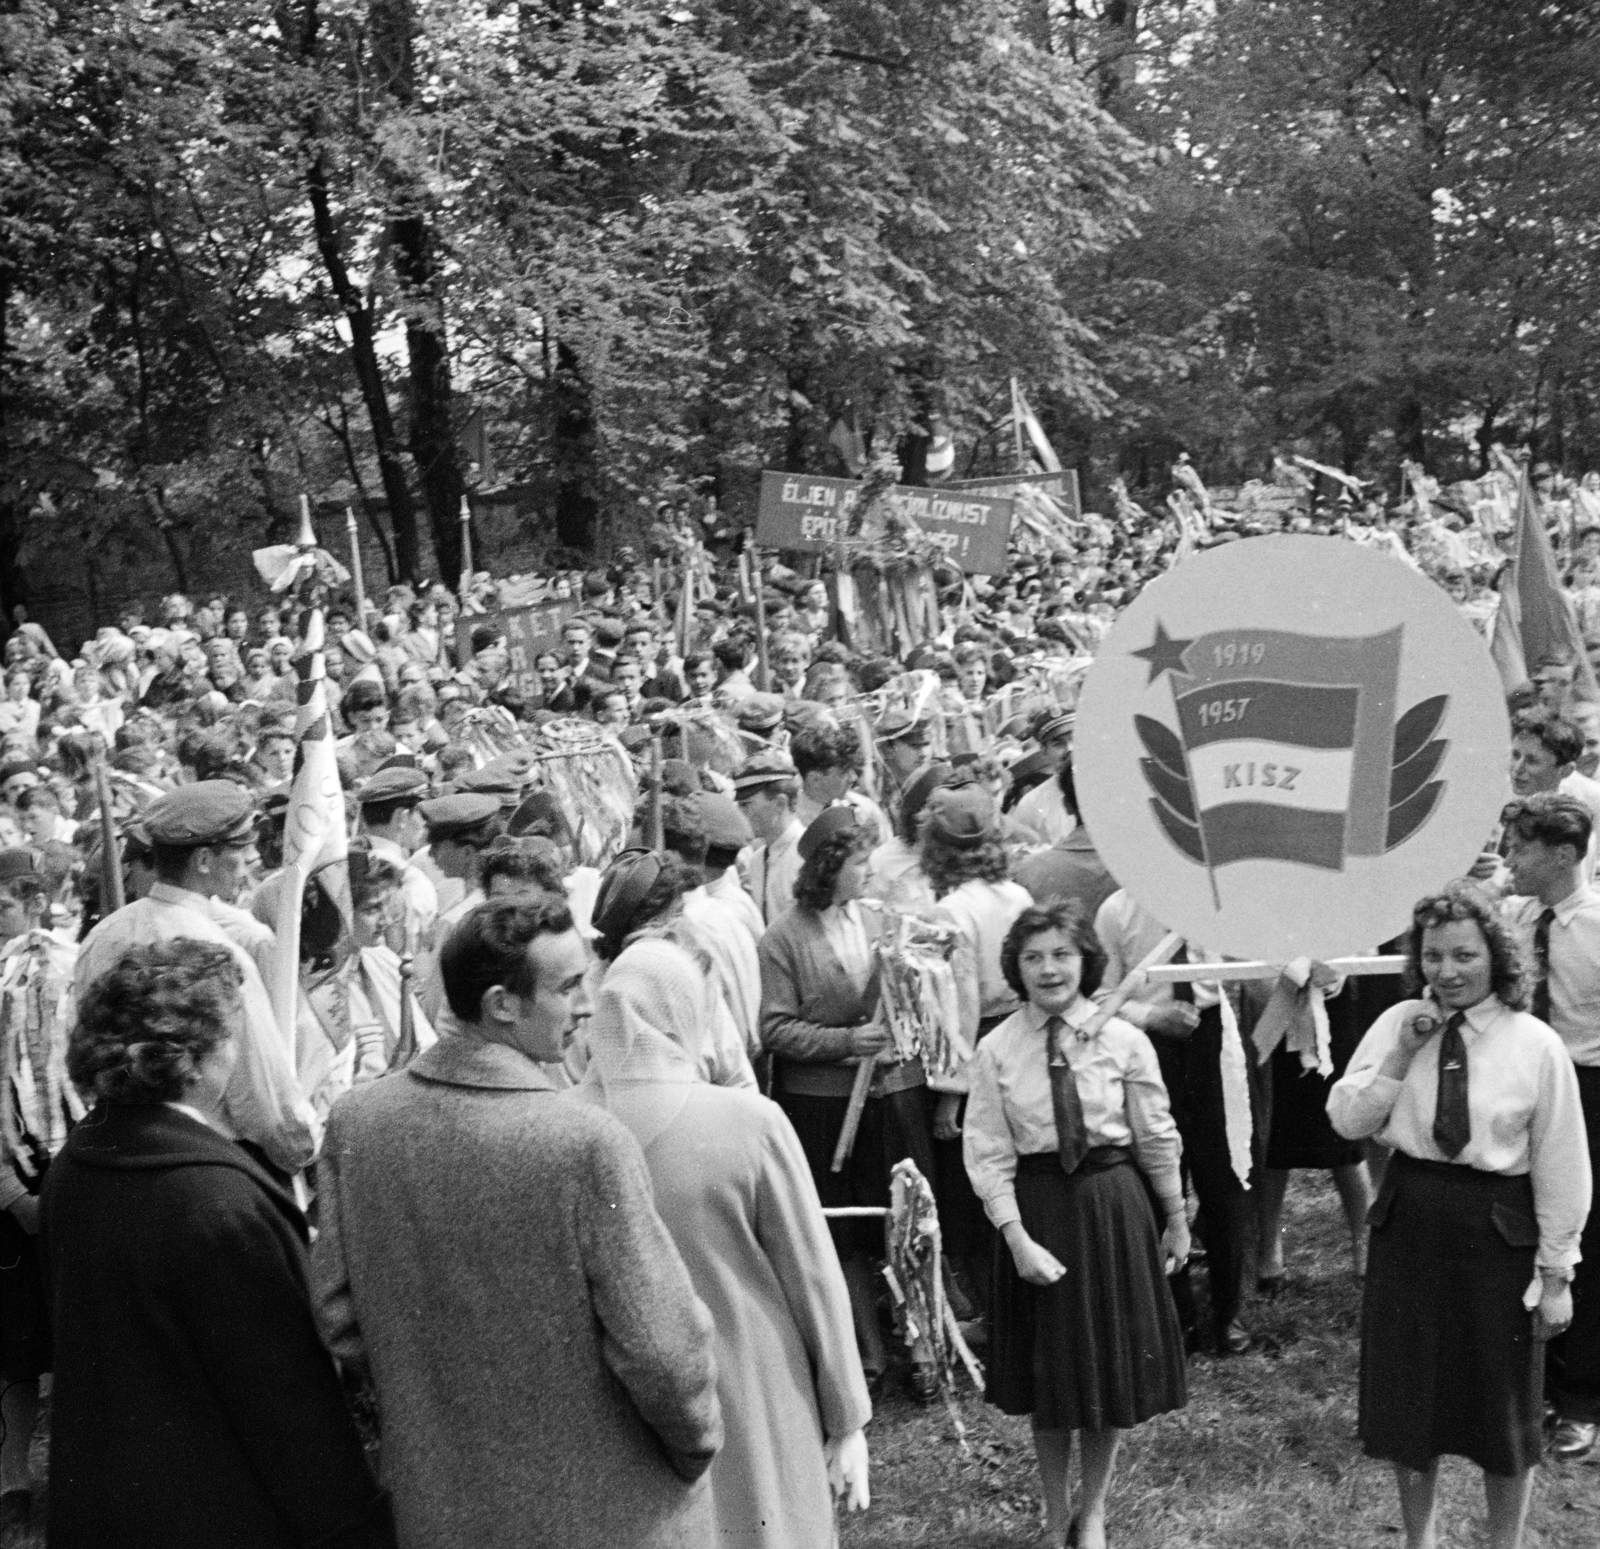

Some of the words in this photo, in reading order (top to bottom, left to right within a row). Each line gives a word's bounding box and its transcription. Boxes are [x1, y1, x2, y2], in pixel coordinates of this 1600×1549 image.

[781, 477, 837, 506] ÉLJEN
[1211, 642, 1266, 668] 1919
[1198, 698, 1252, 727] 1957
[1222, 762, 1302, 791] KISZ
